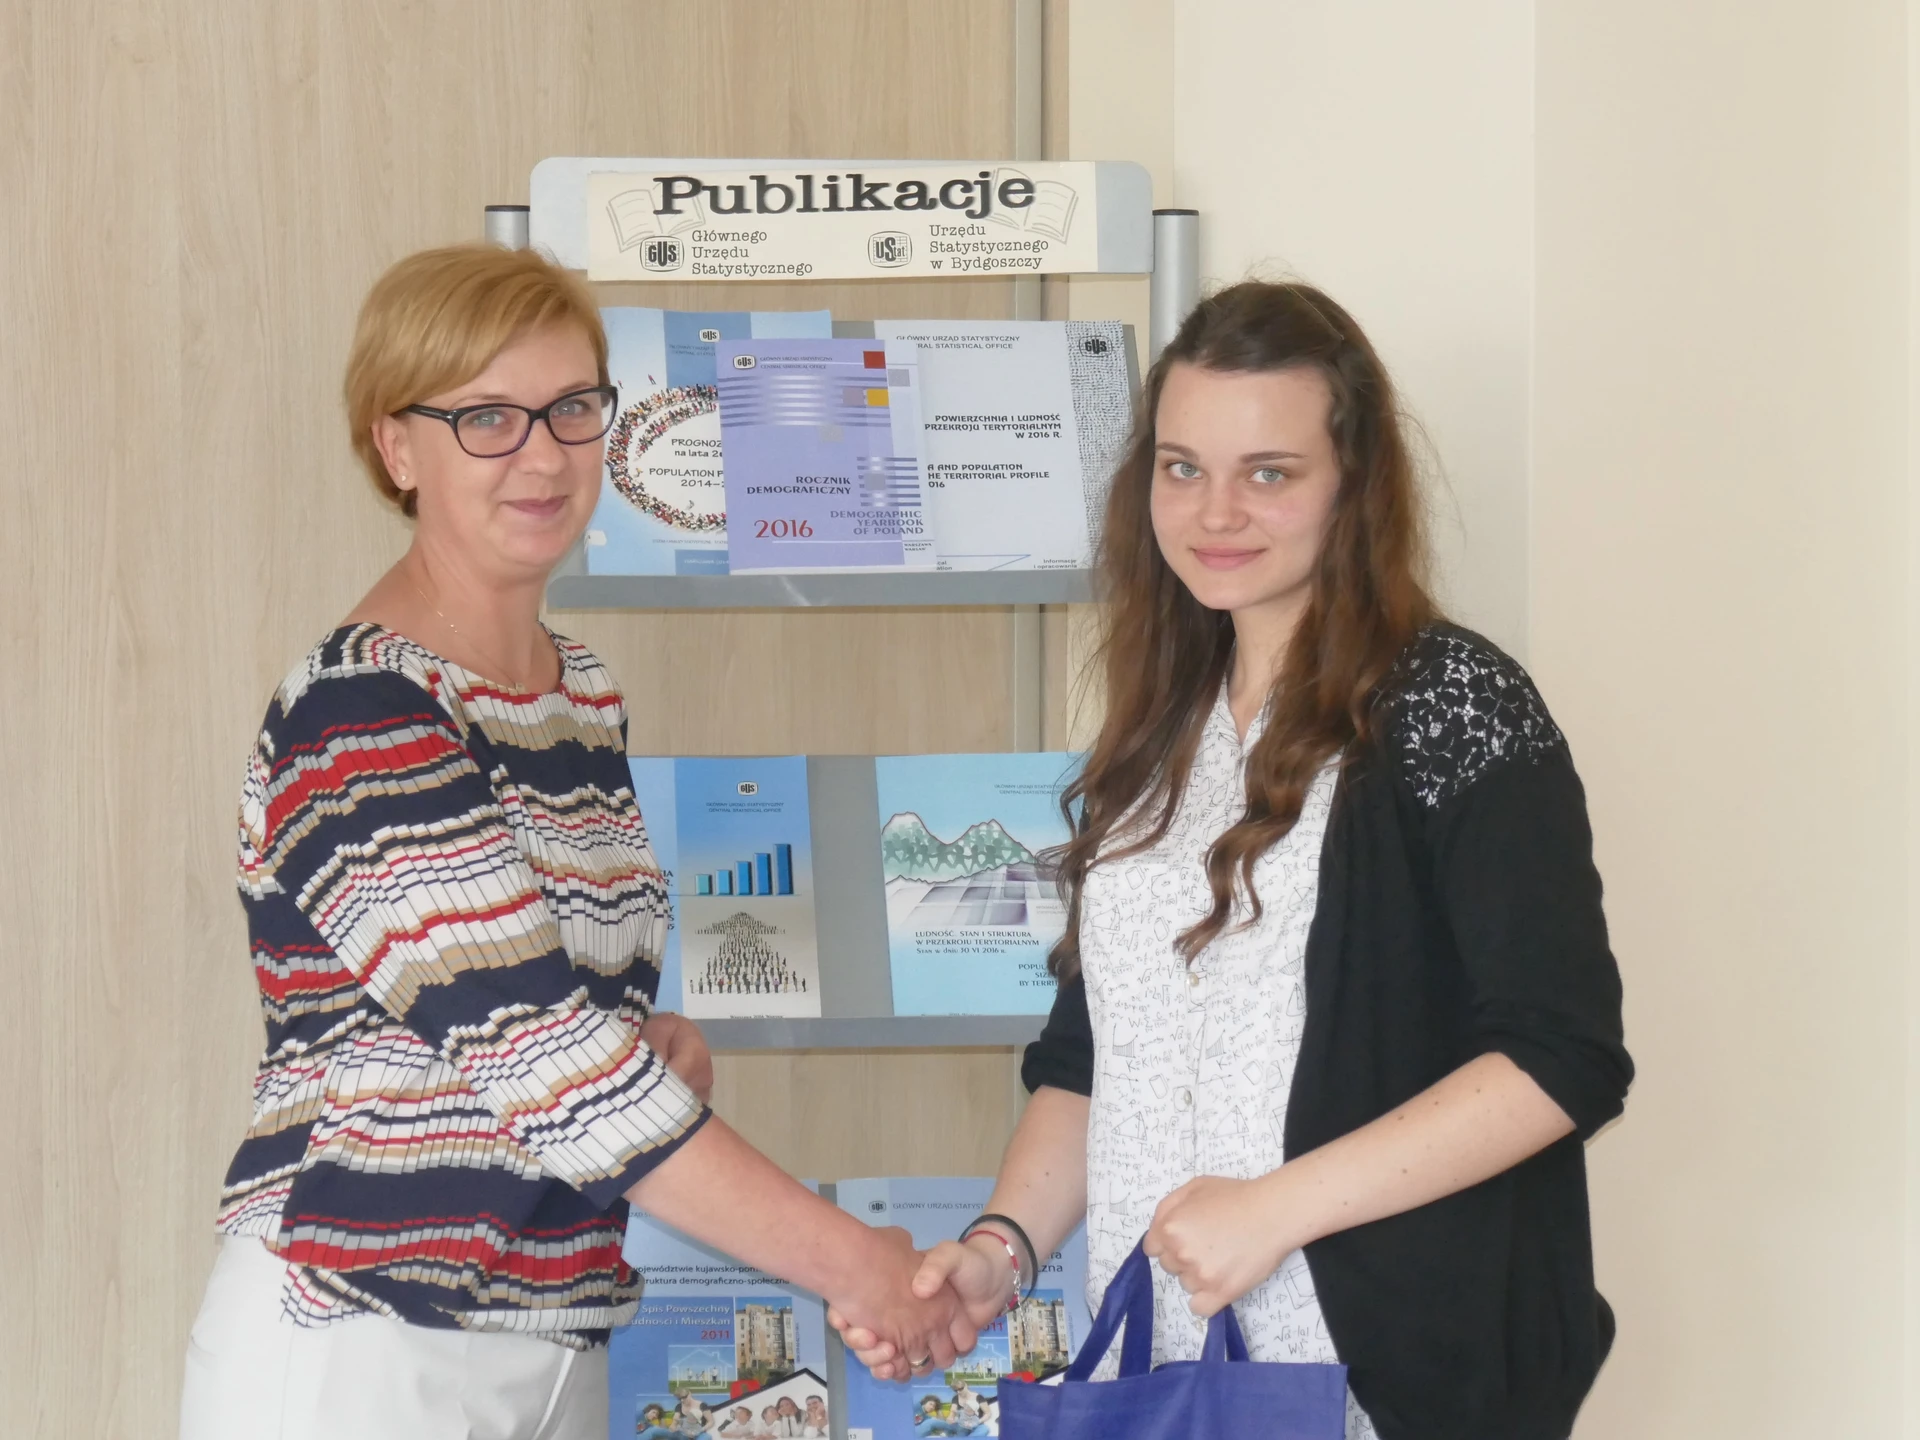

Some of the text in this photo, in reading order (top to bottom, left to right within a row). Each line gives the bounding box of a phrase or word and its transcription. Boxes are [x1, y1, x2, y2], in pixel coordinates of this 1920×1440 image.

[653, 171, 1036, 219] Publikacje
[929, 224, 986, 238] Urzędu
[691, 229, 767, 244] Głównego
[929, 240, 1049, 255] Statystycznego
[648, 241, 677, 267] GUS
[691, 246, 750, 260] Urzędu
[930, 257, 1042, 271] w Bydgoszczy
[691, 262, 813, 277] Statystycznego
[702, 331, 717, 340] GUS
[1085, 339, 1107, 354] GUS
[737, 356, 752, 367] GUS
[1017, 413, 1061, 422] LUDNOŚĆ
[924, 423, 1062, 431] PRZEKROJU TERYTORIALNYM
[671, 438, 722, 448] PROGNOZ
[688, 449, 709, 457] lata
[961, 463, 1023, 471] POPULATION
[649, 468, 715, 477] POPULATION
[944, 472, 1007, 480] TERRITORIAL
[1010, 471, 1050, 479] PROFILE
[795, 476, 851, 484] ROCZNIK
[746, 486, 851, 495] DEMOGRAFICZNY
[830, 510, 922, 519] DEMOGRAPHIC
[857, 518, 924, 527] YEARBOOK
[754, 519, 814, 538] 2016
[853, 526, 924, 535] OF POLAND
[740, 783, 755, 793] GUS
[987, 930, 1032, 938] STRUKTURA
[892, 1202, 985, 1211] GŁÓWNY URZĄD STATYST
[644, 1276, 677, 1285] ruktura
[641, 1304, 730, 1315] Spis Powszechny
[702, 1329, 730, 1340] 2011
